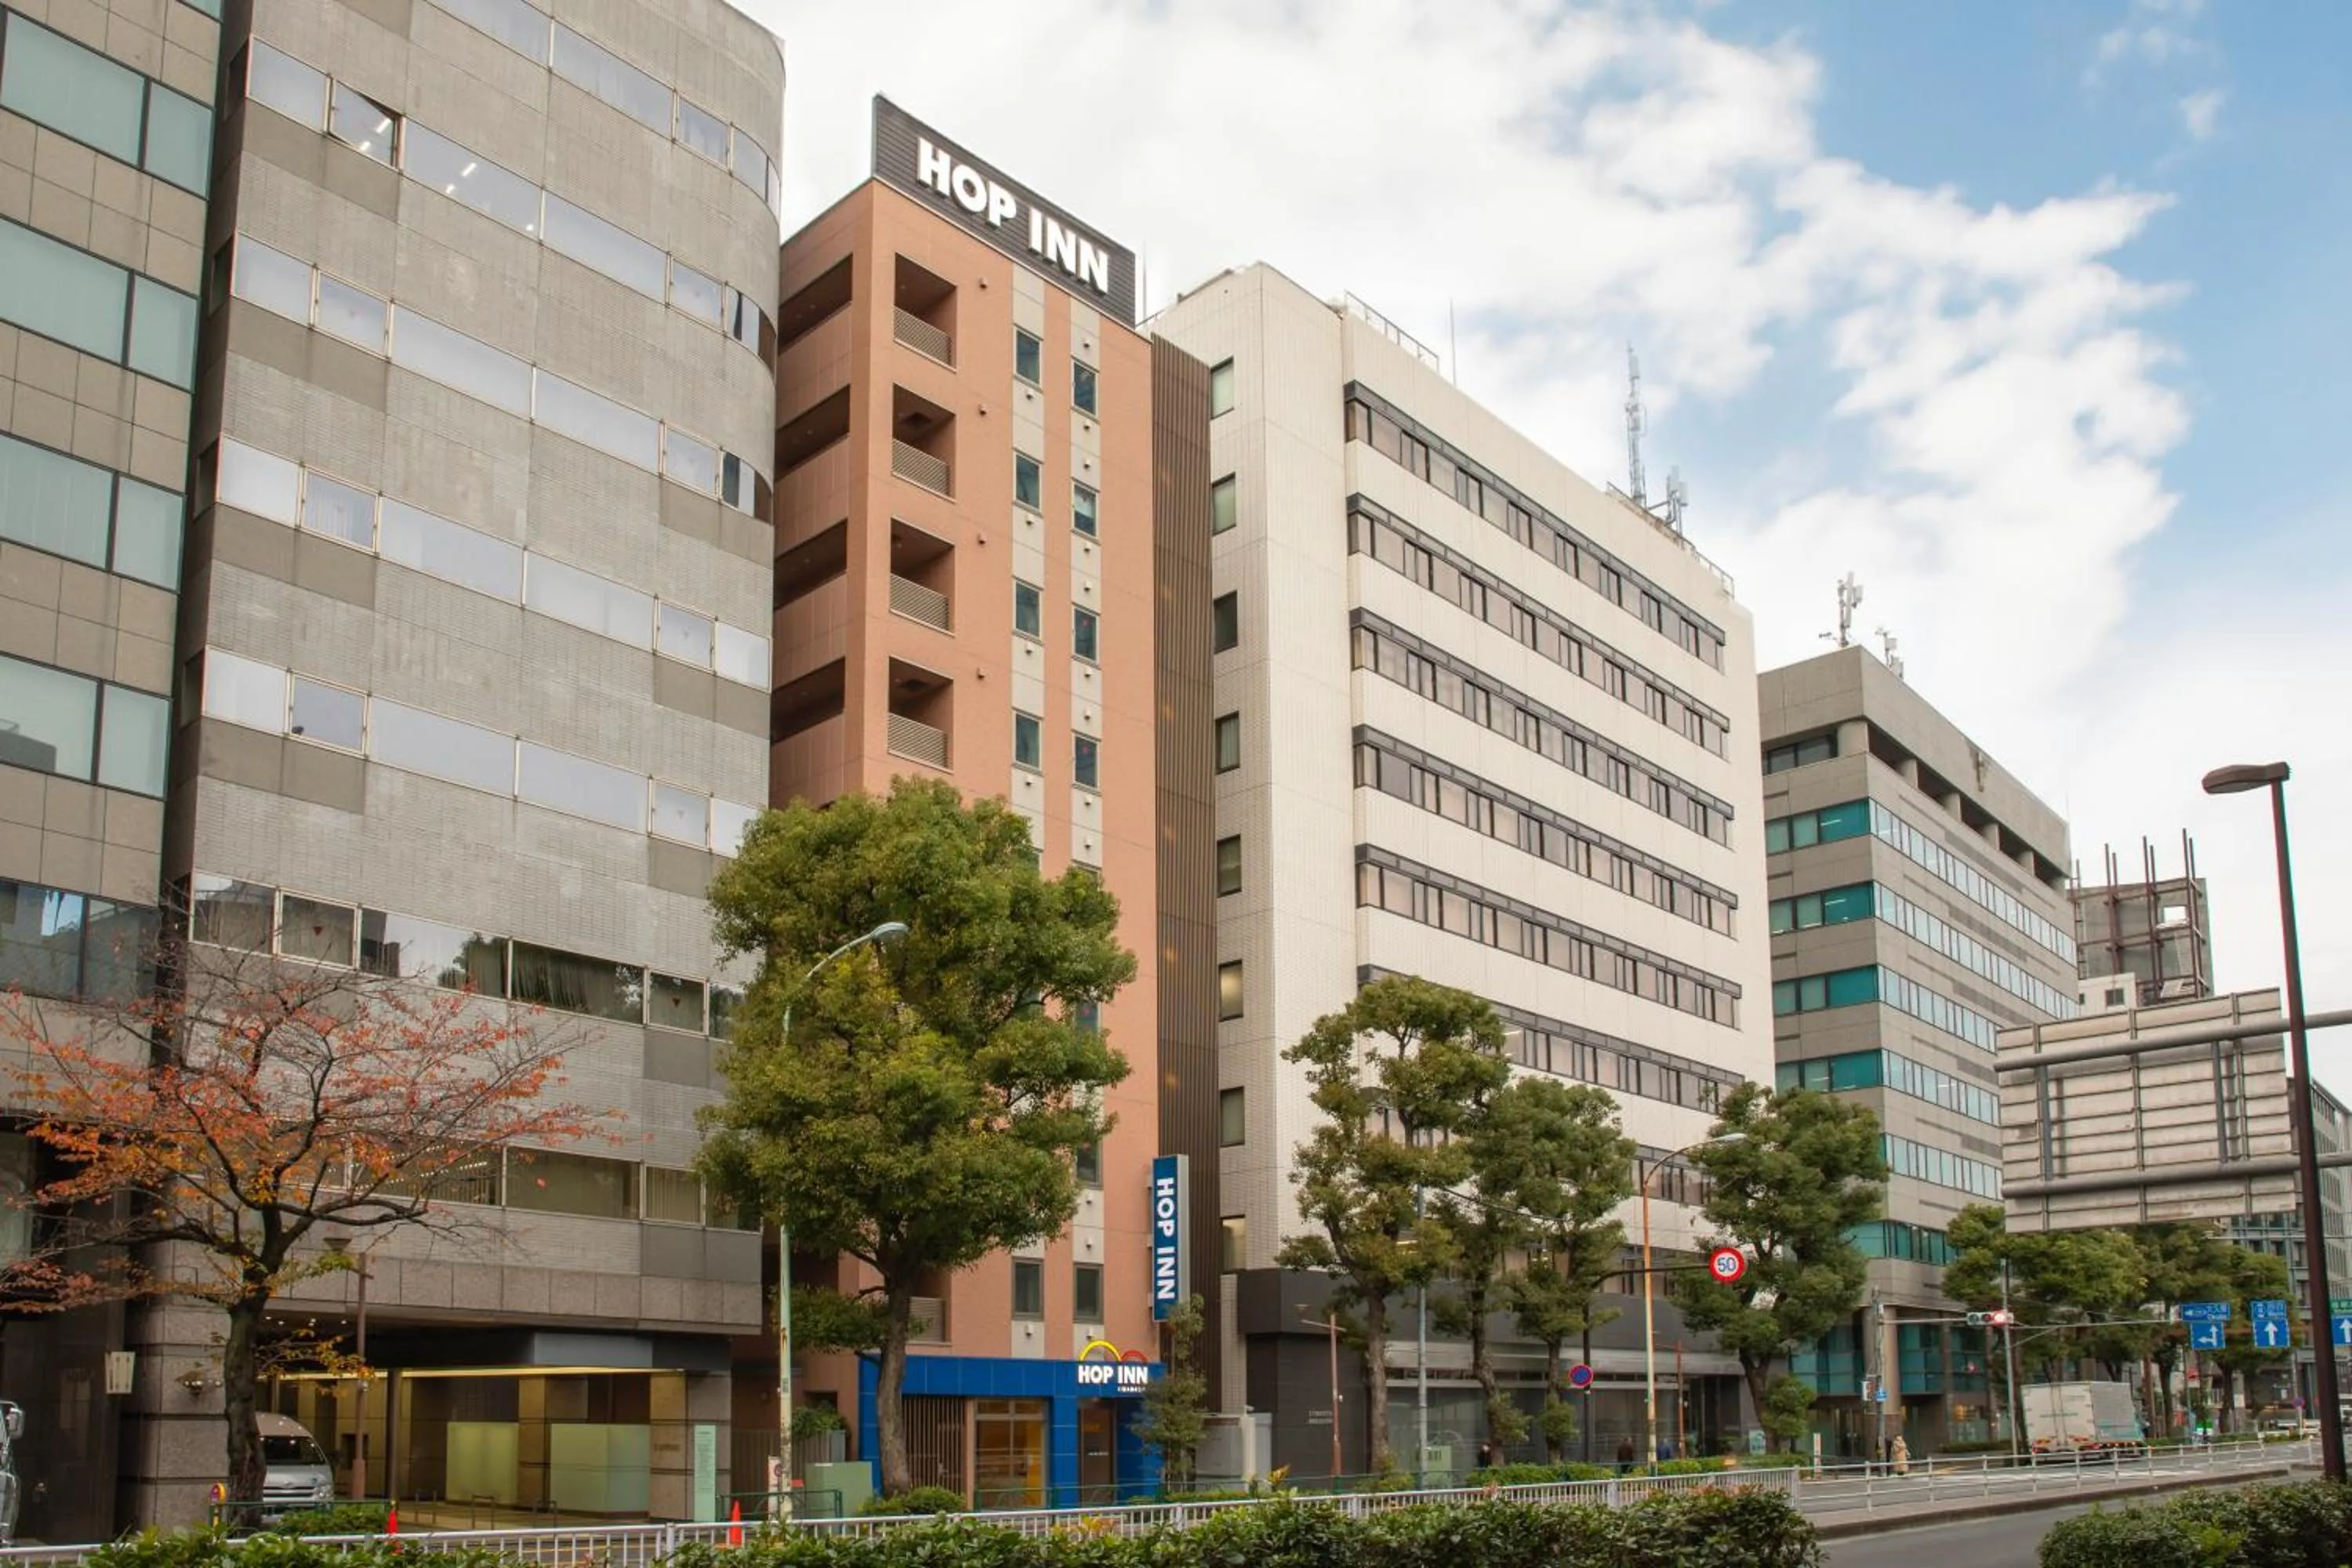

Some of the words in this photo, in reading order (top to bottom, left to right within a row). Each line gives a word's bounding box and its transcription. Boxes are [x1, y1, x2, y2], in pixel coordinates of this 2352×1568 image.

[919, 137, 1017, 227] HOP
[1028, 205, 1109, 295] INN
[1156, 1178, 1175, 1237] HOP
[1156, 1246, 1176, 1300] INN
[1718, 1258, 1736, 1272] 50
[1078, 1365, 1113, 1385] HOP
[1117, 1365, 1149, 1385] INN
